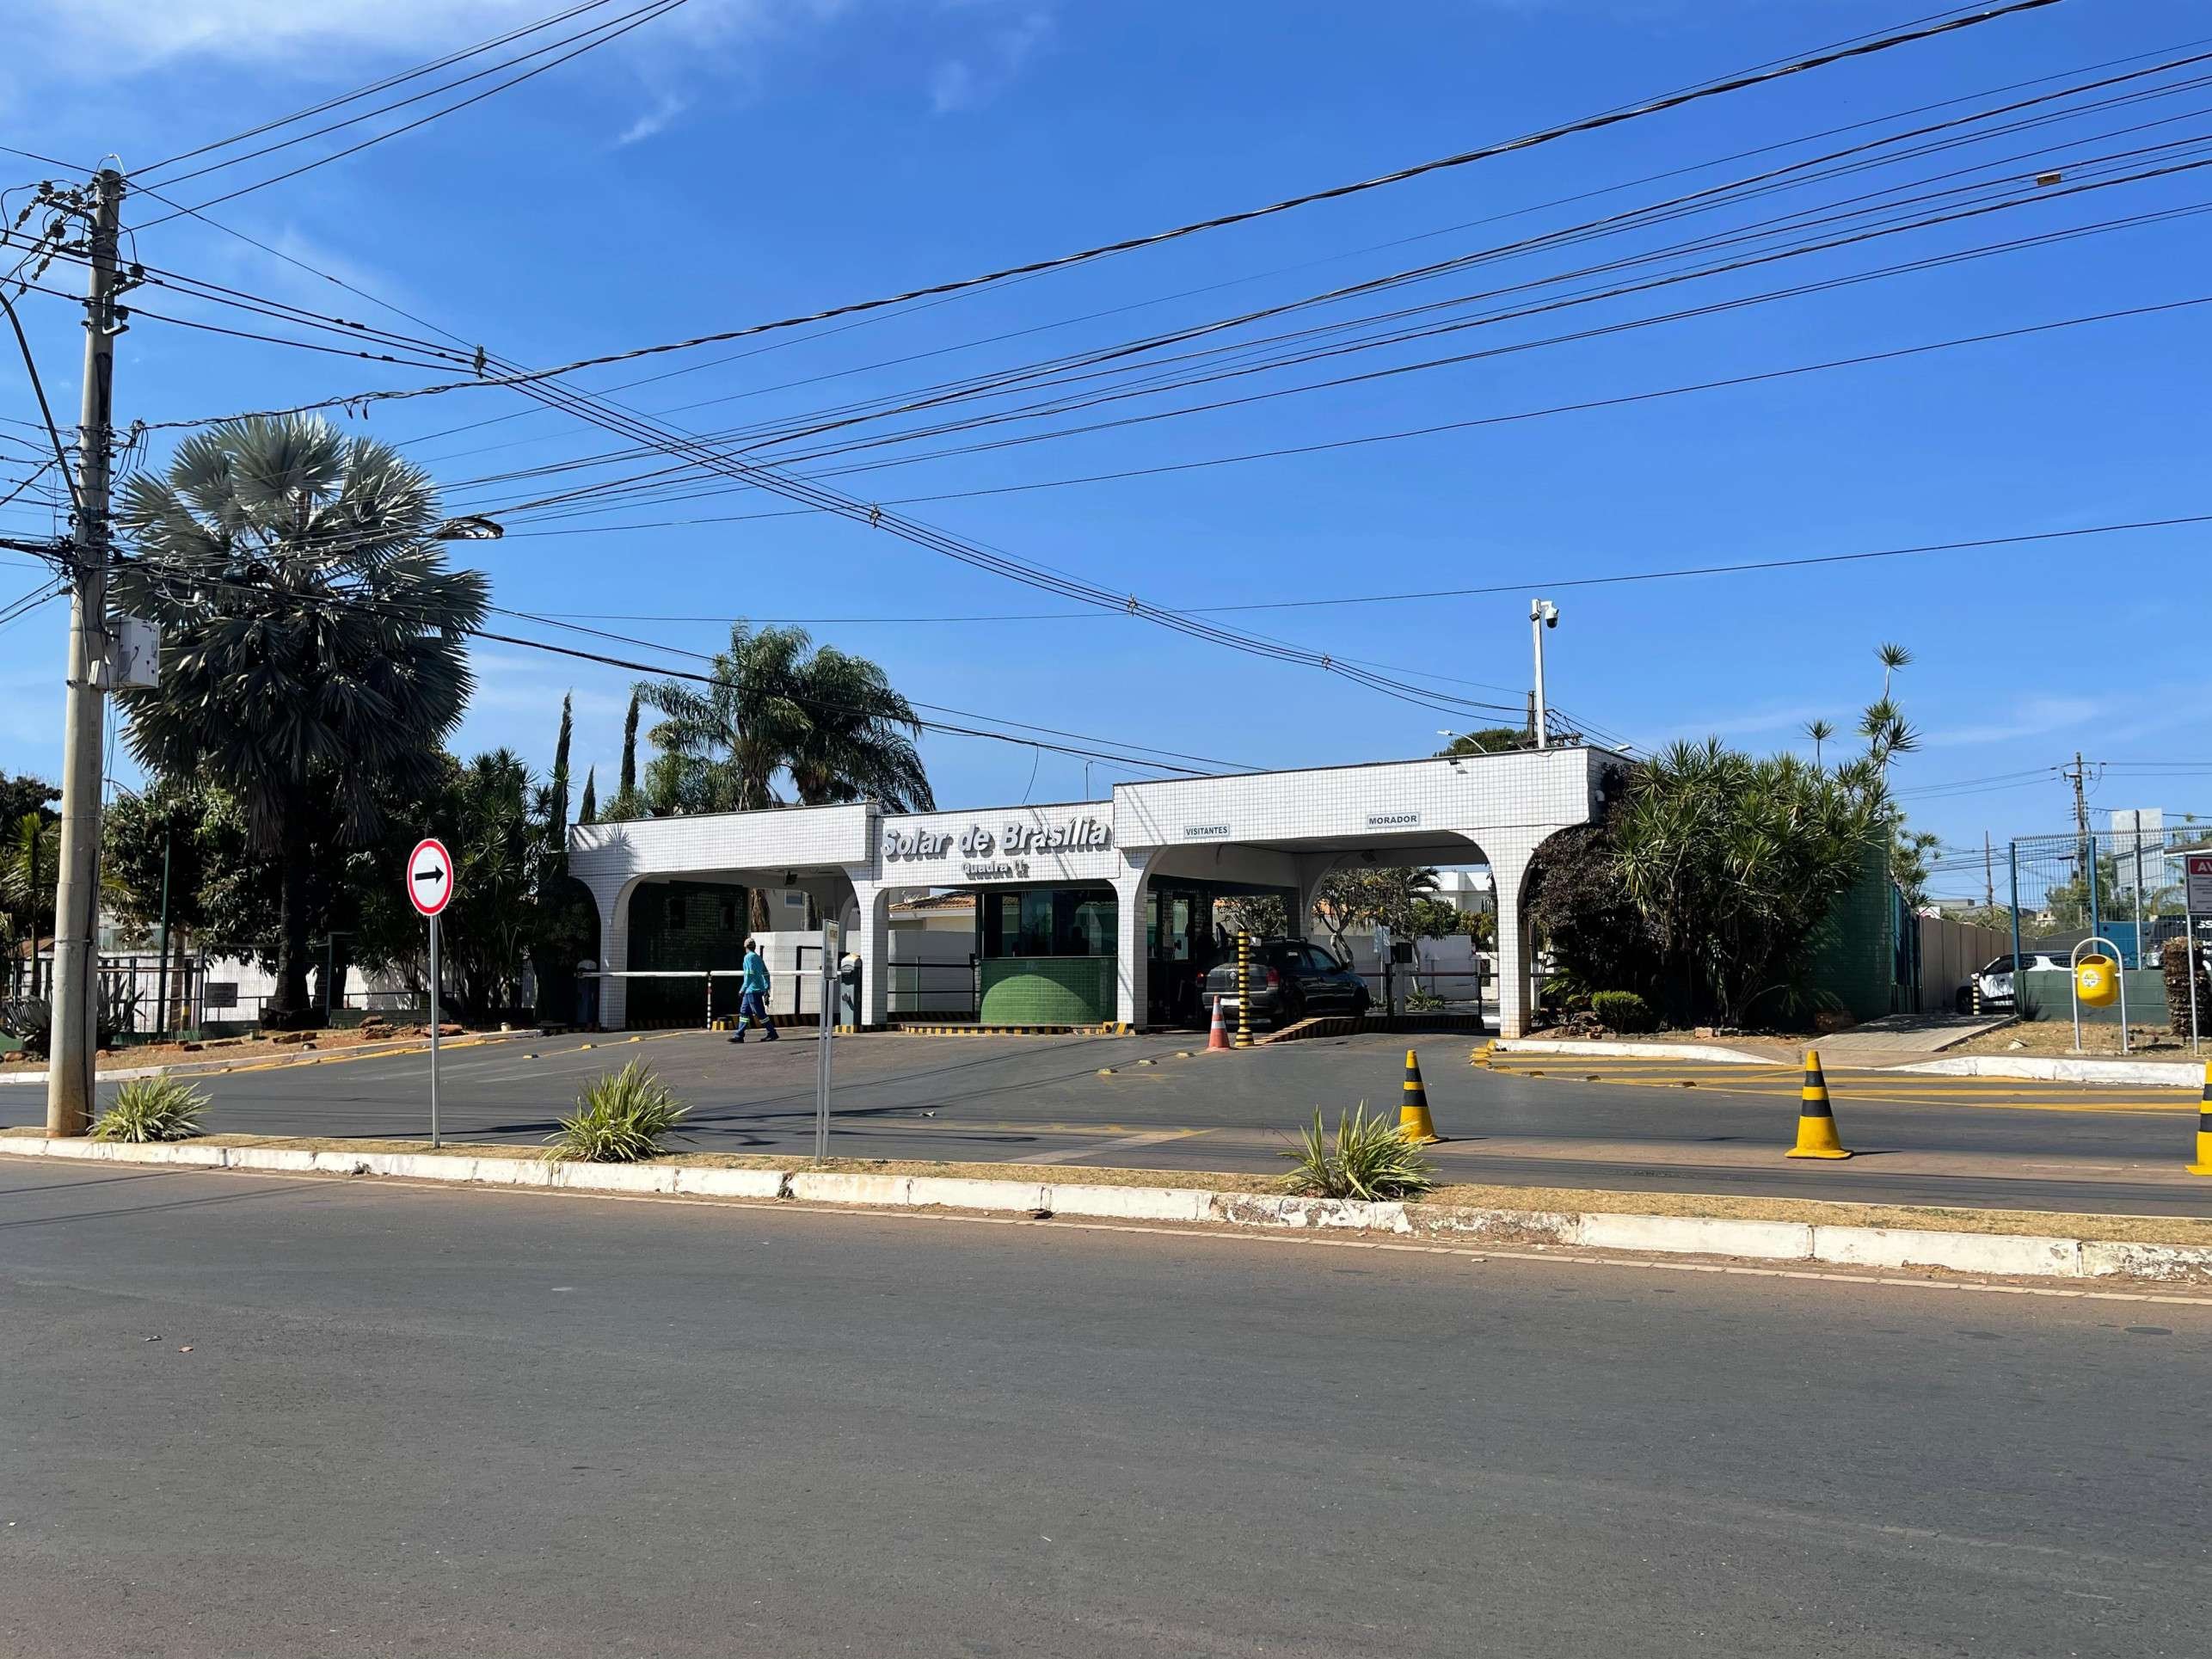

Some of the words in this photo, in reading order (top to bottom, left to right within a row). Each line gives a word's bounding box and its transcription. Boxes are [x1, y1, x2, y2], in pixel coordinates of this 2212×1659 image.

[1369, 815, 1416, 824] MORADOR
[880, 827, 950, 858] Solar
[957, 824, 992, 855] de
[999, 813, 1110, 851] Brasília
[1186, 826, 1227, 835] VISITANTES
[962, 860, 1011, 876] Quadra
